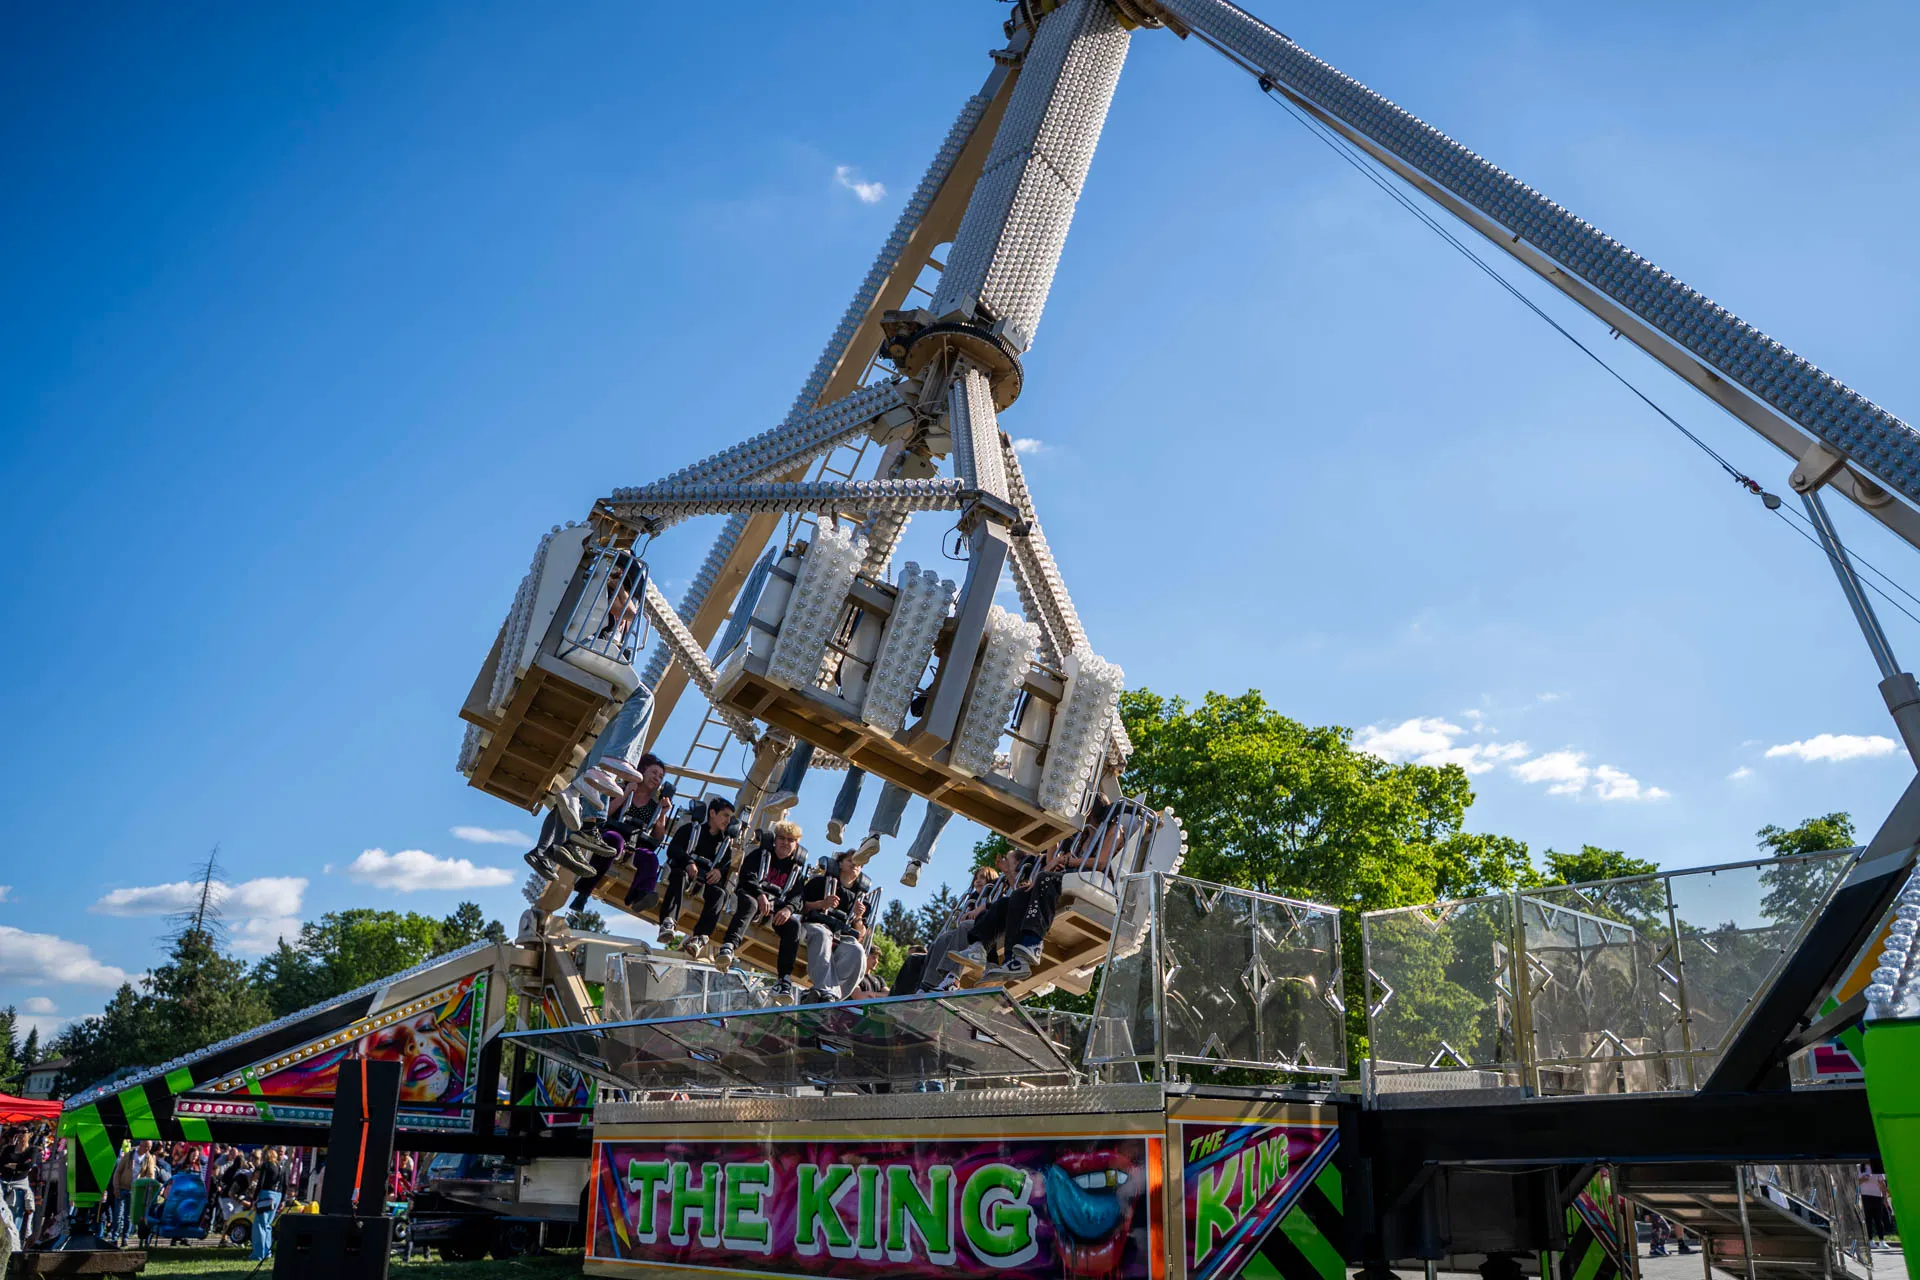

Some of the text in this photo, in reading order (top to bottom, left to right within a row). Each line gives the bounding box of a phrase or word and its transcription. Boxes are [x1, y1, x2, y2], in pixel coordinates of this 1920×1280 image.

[1189, 1129, 1225, 1162] THE
[628, 1158, 1038, 1268] THE KING
[1194, 1133, 1289, 1269] KING
